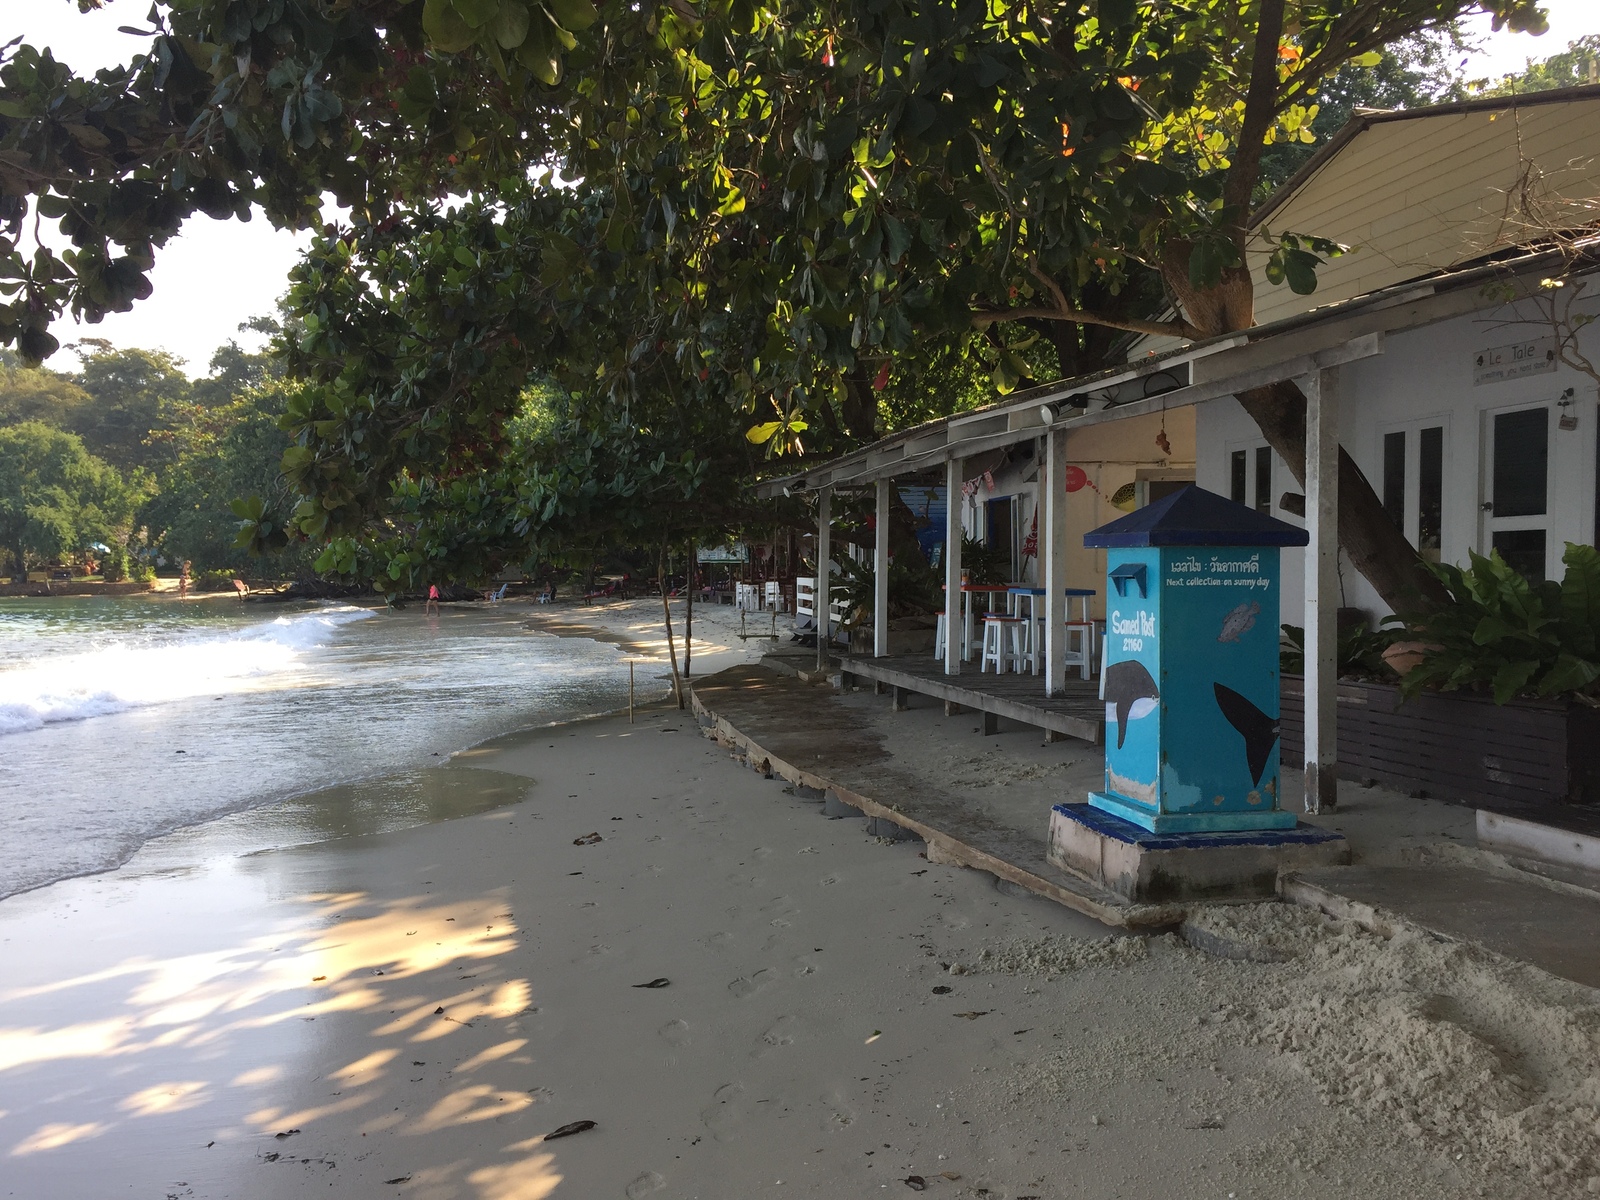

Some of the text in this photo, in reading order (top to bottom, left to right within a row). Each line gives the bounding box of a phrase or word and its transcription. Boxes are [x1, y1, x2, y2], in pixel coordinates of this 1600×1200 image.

[1489, 344, 1535, 366] Le Tale
[1209, 553, 1259, 573] วันอากาศดี
[1166, 578, 1184, 586] Next
[1233, 579, 1256, 590] sunny
[1257, 577, 1270, 591] day
[1112, 610, 1156, 638] Samed Post
[1122, 638, 1143, 652] 21160
